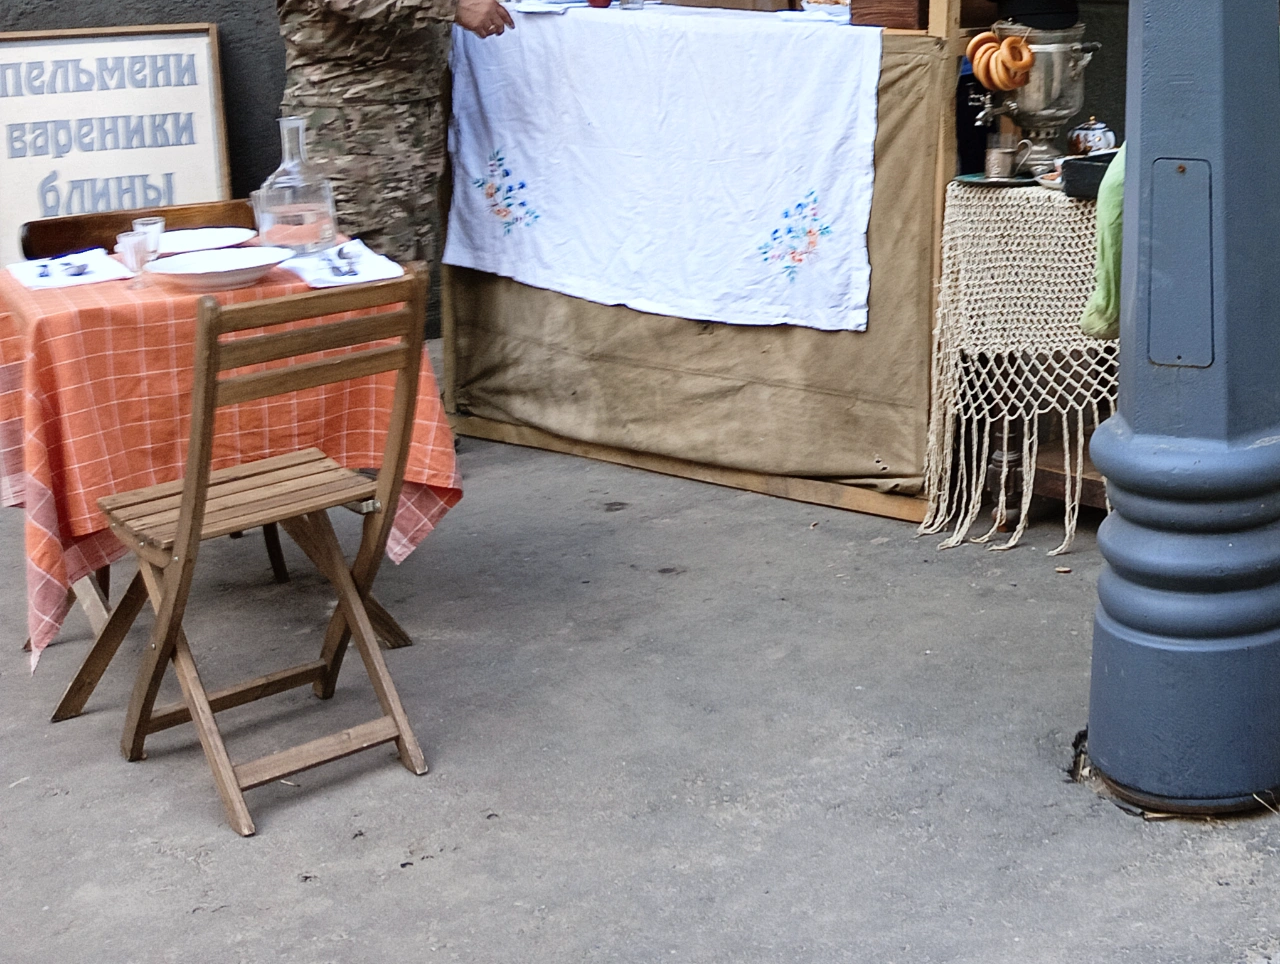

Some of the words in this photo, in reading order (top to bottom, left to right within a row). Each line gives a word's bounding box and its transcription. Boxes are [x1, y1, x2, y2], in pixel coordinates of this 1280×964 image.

[0, 53, 198, 98] пельмени
[6, 112, 197, 158] вареники
[38, 169, 175, 217] блины
